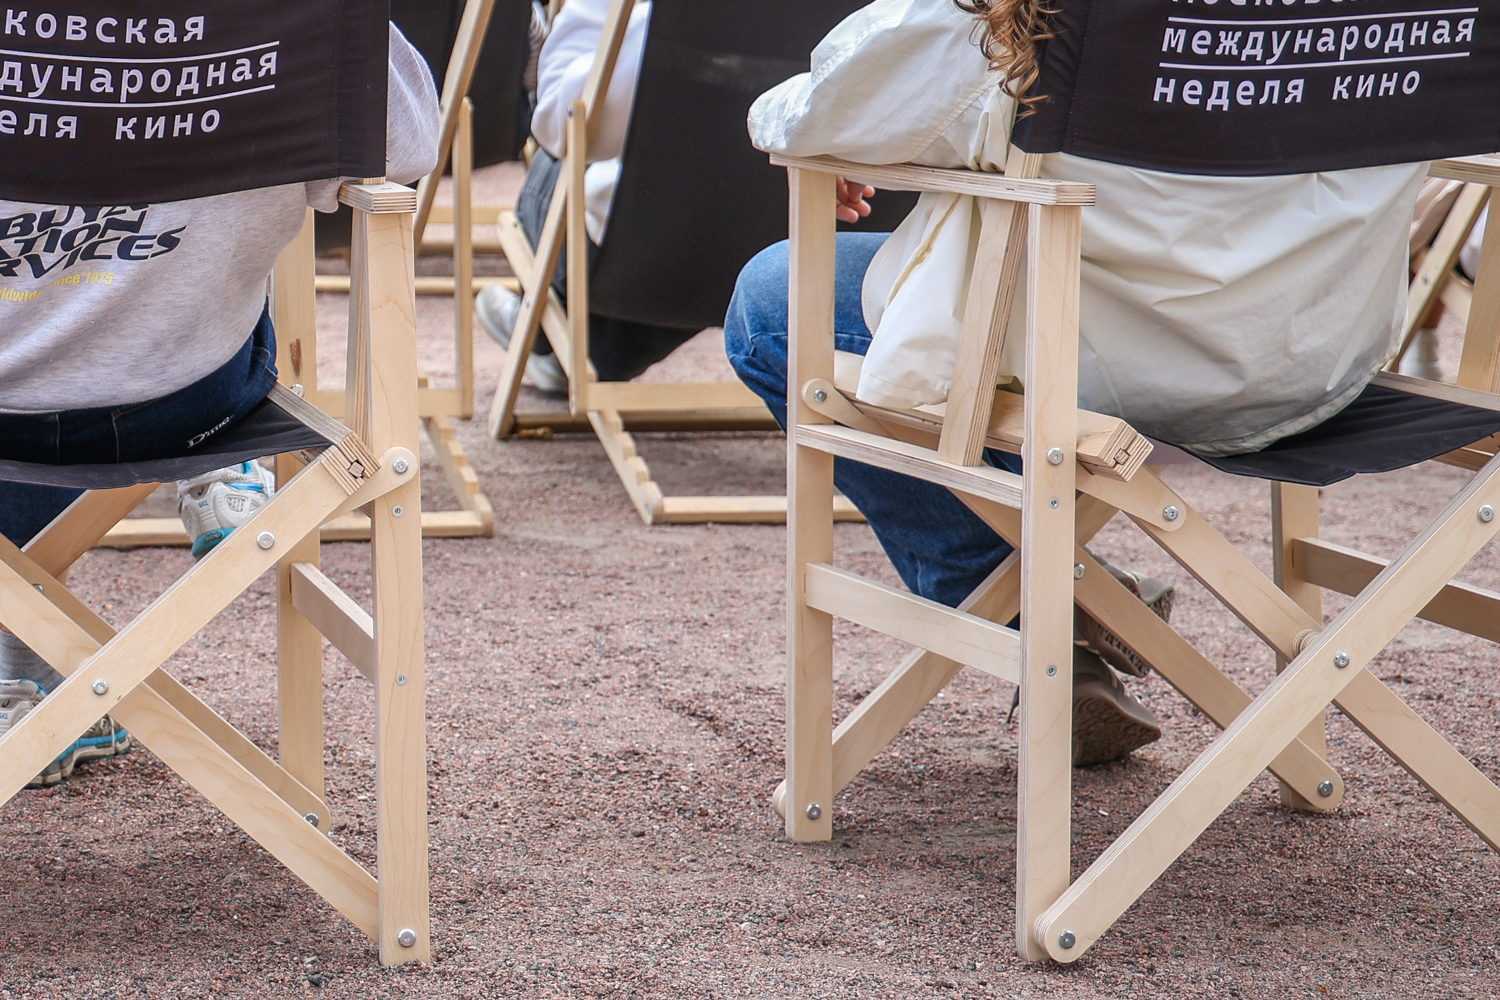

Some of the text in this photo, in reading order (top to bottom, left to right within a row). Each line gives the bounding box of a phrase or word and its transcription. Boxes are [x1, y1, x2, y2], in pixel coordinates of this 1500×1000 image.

[1161, 17, 1476, 65] международная
[1152, 70, 1421, 112] неделя кино
[115, 109, 221, 141] кино
